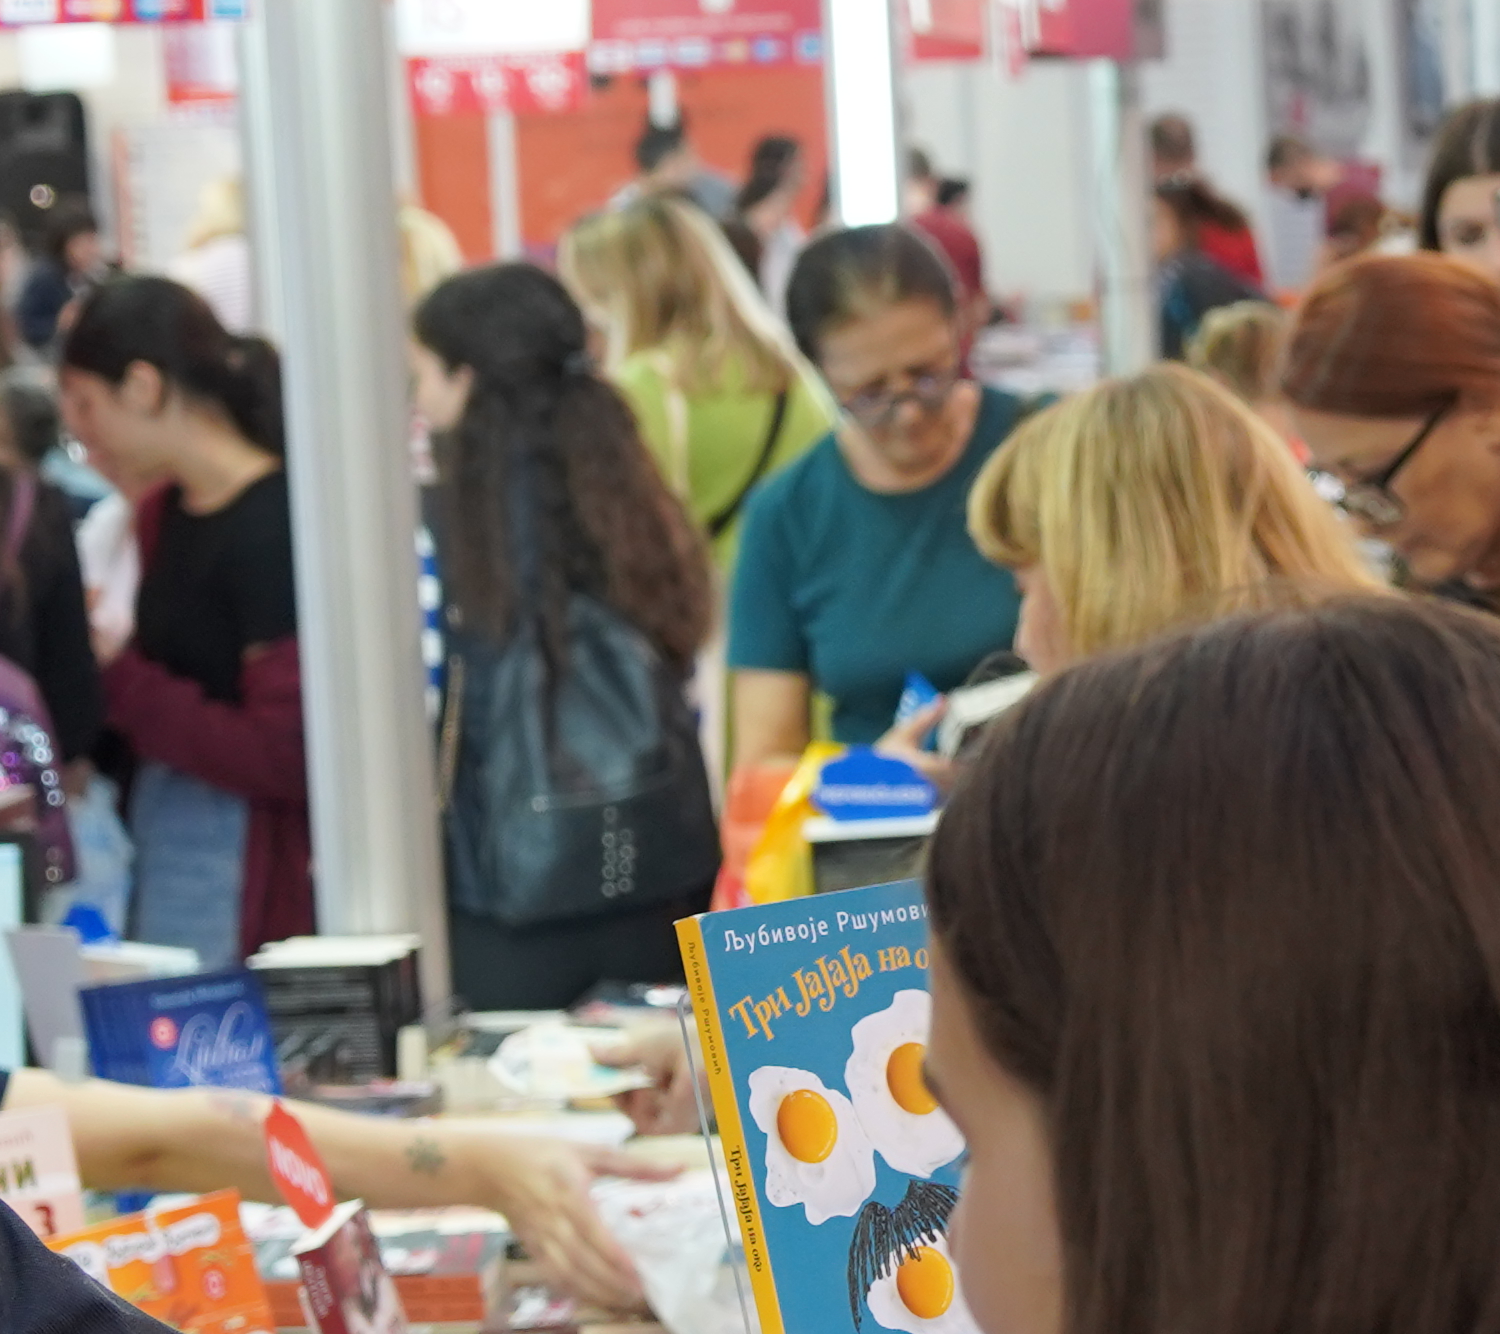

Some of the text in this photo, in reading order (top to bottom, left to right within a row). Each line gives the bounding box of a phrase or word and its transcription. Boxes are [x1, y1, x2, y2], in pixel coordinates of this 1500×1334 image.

[724, 903, 930, 953] Љубивоје Ршумови
[728, 986, 792, 1041] Три
